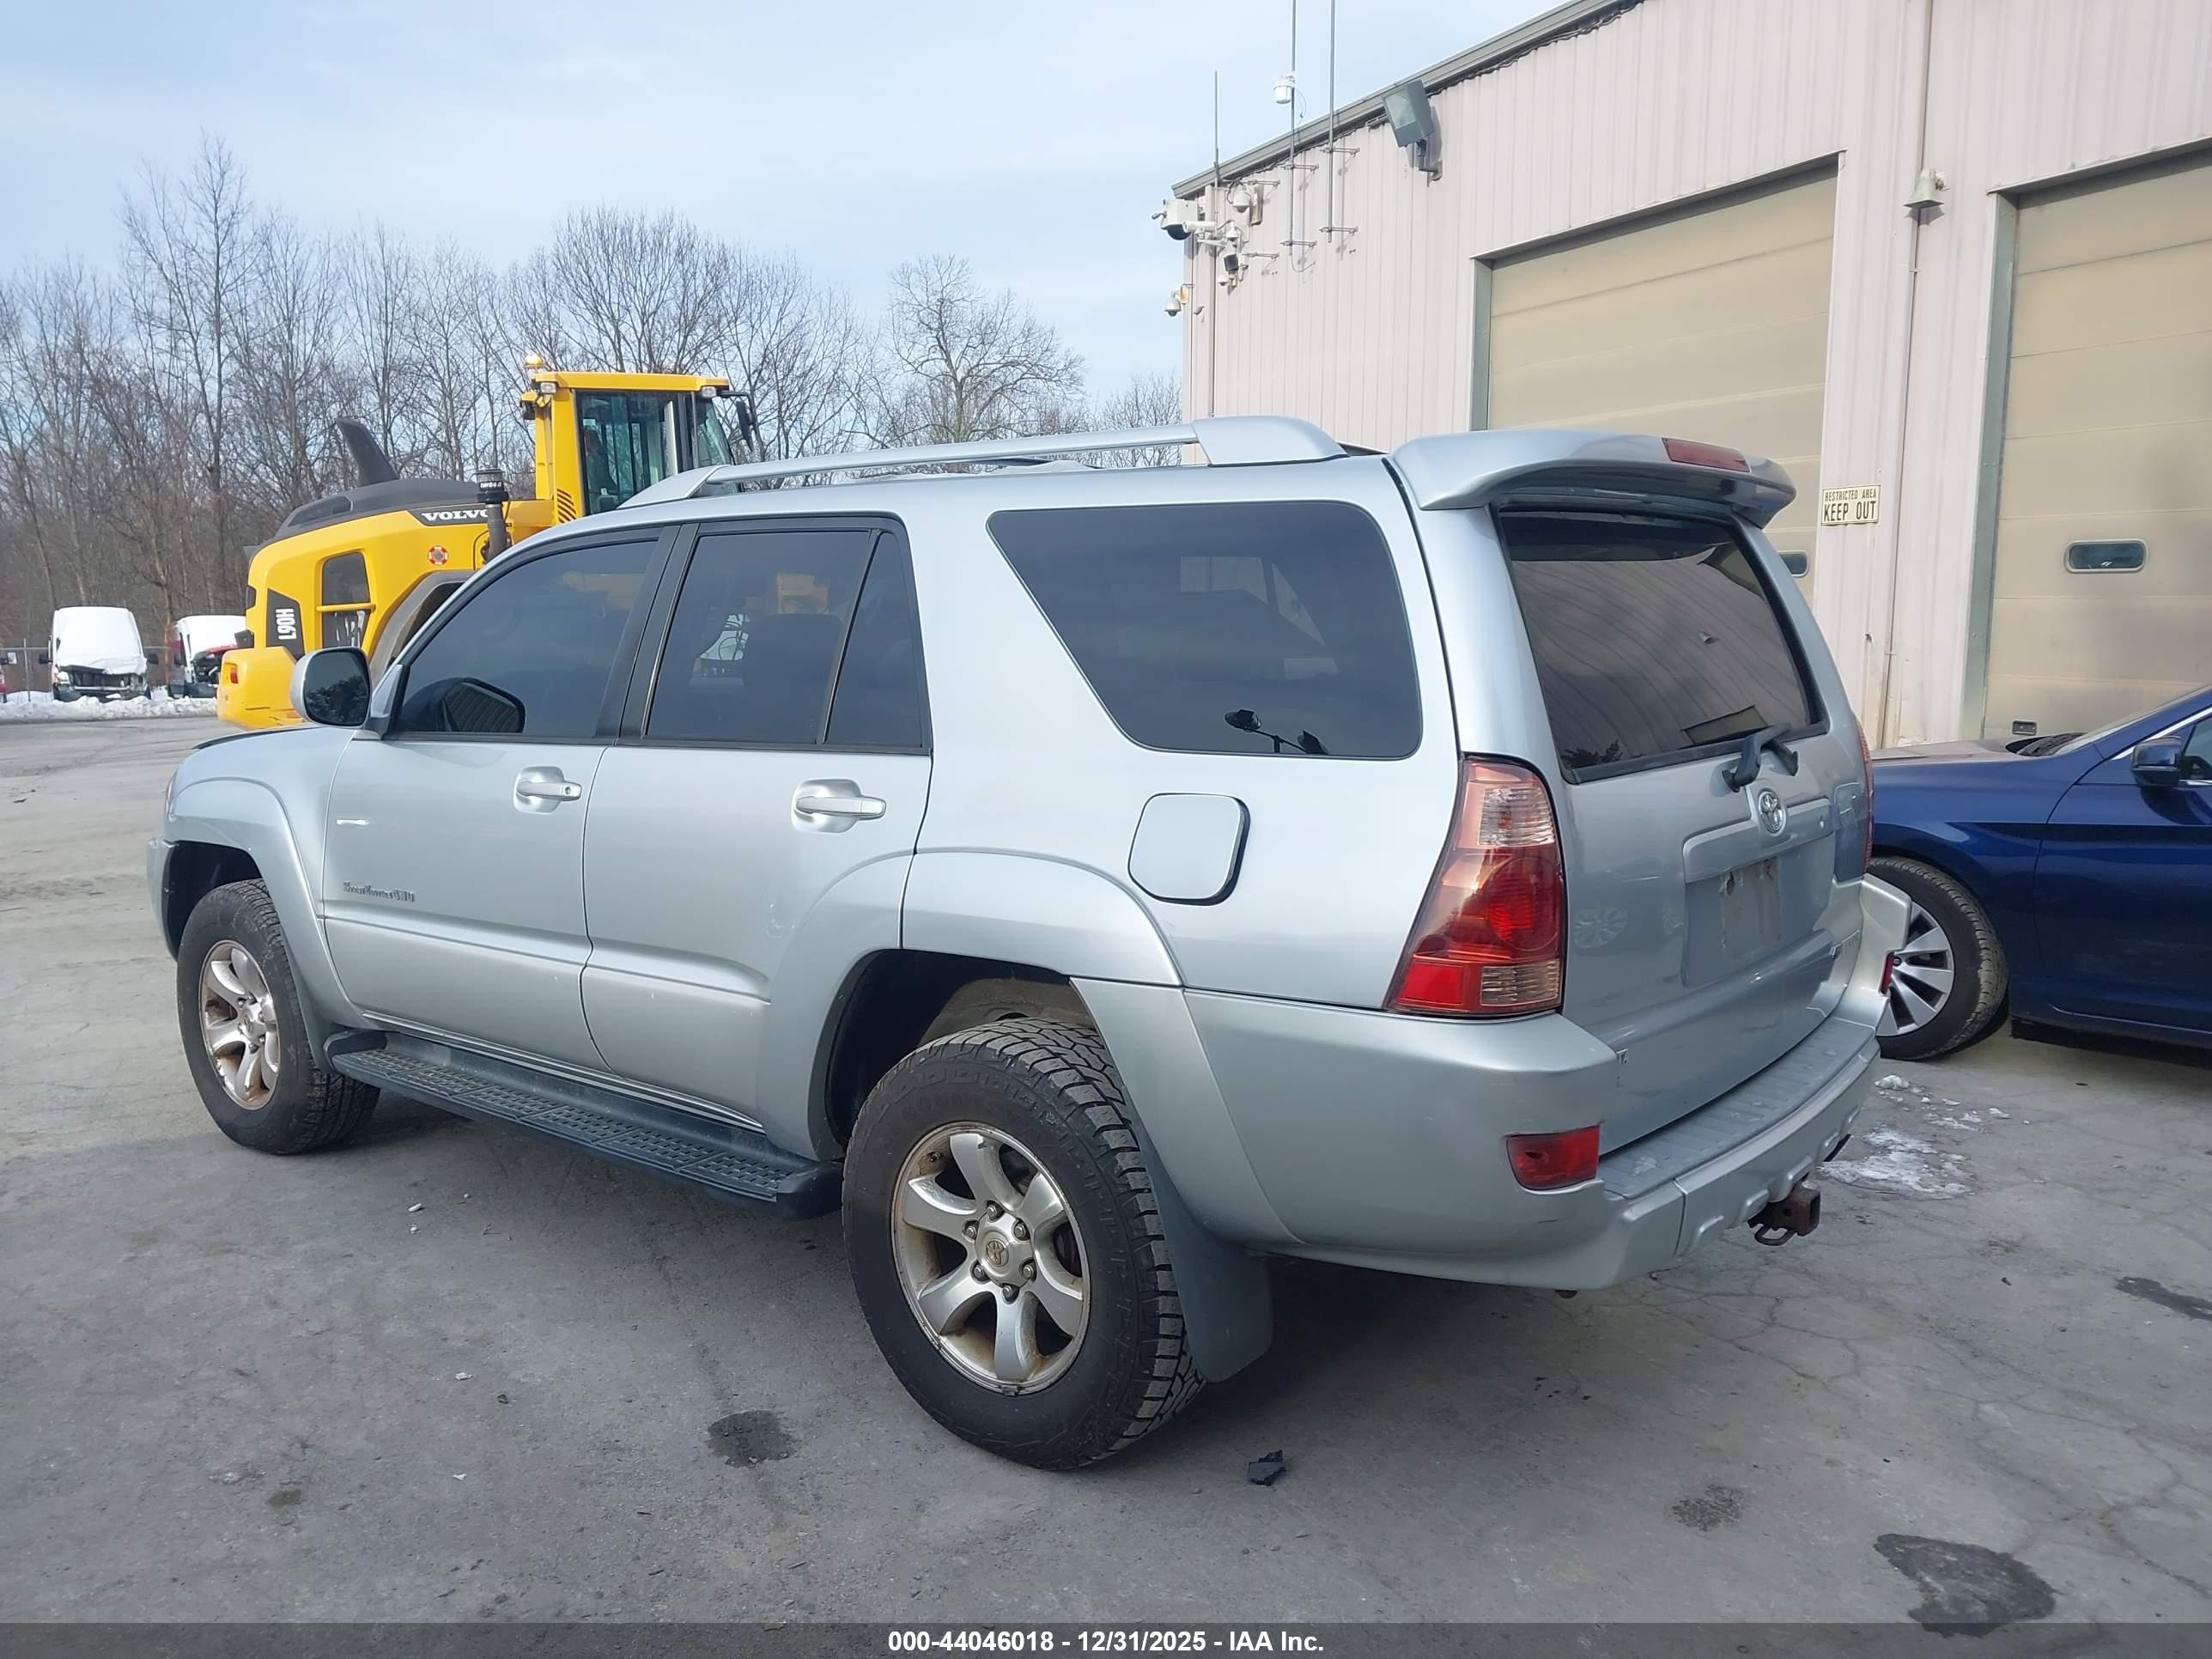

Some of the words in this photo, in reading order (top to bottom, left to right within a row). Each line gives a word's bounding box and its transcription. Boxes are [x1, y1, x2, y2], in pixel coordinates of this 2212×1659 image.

[1825, 489, 1858, 501] RESTRICTED
[1862, 488, 1876, 499] AREA
[1823, 502, 1849, 521] KEEP
[1856, 501, 1876, 520] OUT
[275, 608, 297, 640] L90H
